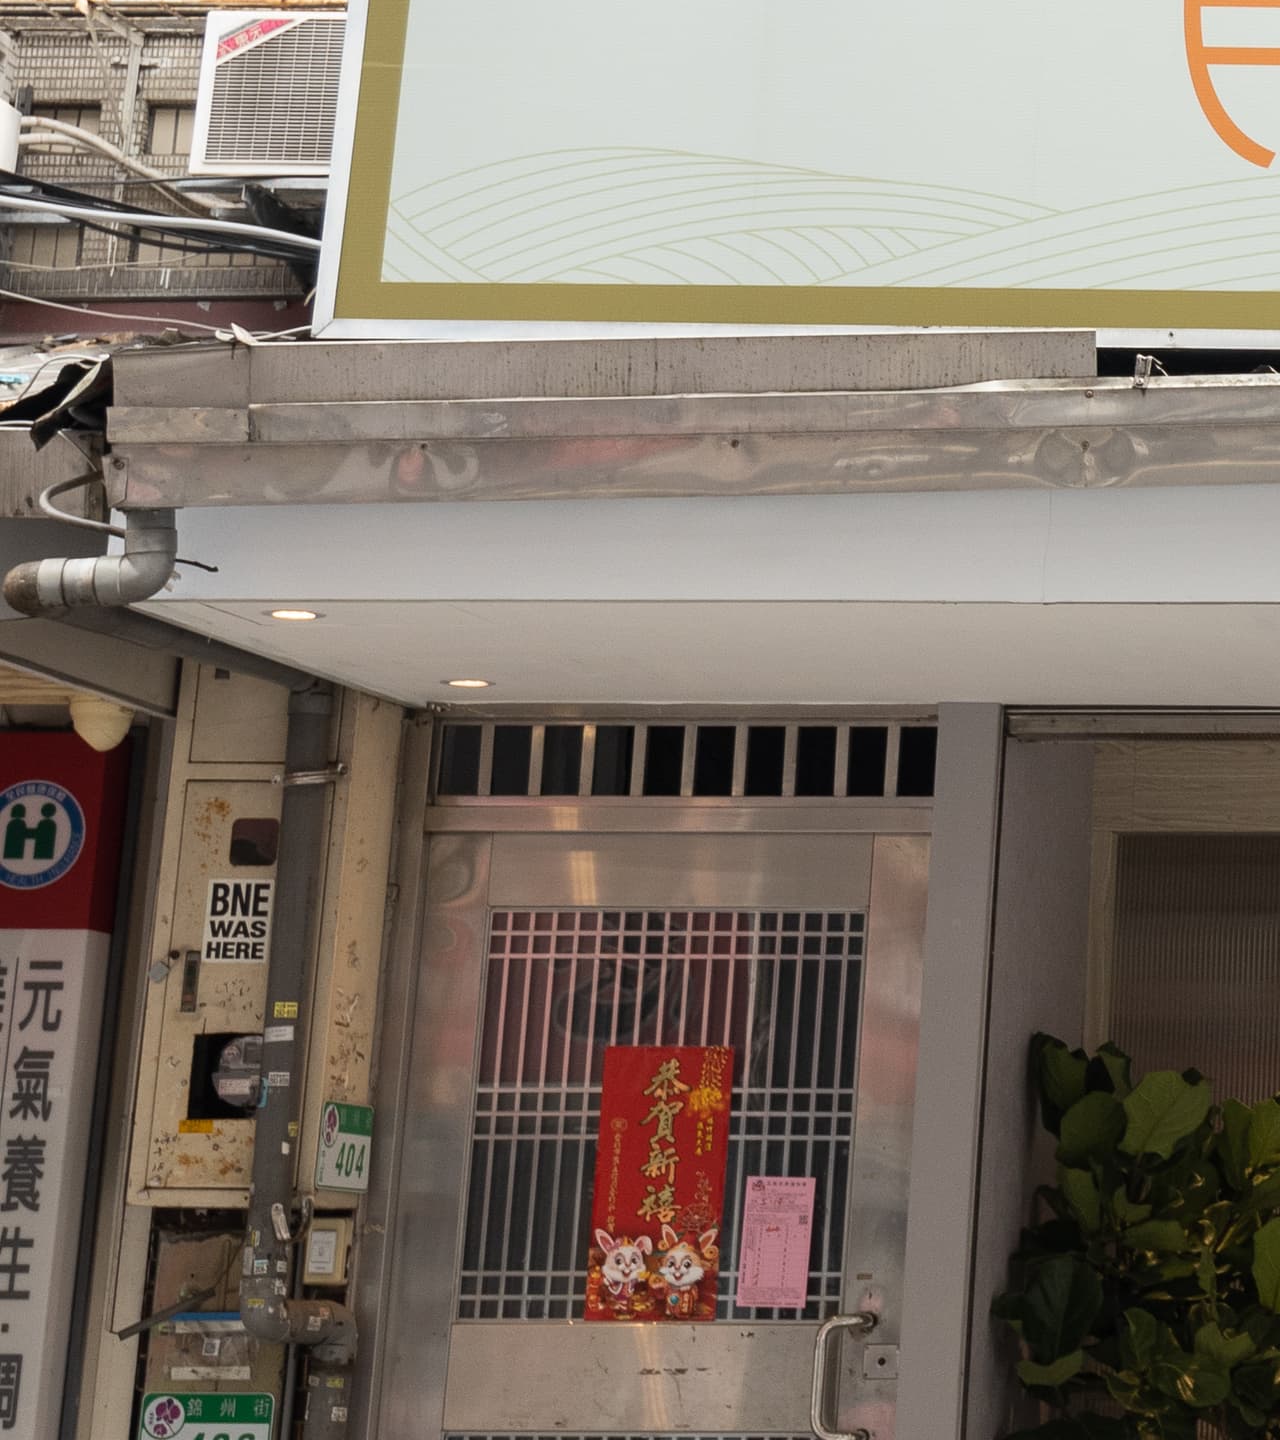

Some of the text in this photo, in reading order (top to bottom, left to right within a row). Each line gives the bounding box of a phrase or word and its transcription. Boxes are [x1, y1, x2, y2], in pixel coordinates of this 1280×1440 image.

[210, 883, 270, 916] BNE
[209, 920, 266, 938] WAS
[206, 942, 265, 959] HERE
[638, 1057, 691, 1224] 恭賀新禧
[336, 1142, 366, 1178] 404
[186, 1396, 269, 1418] 錦州街
